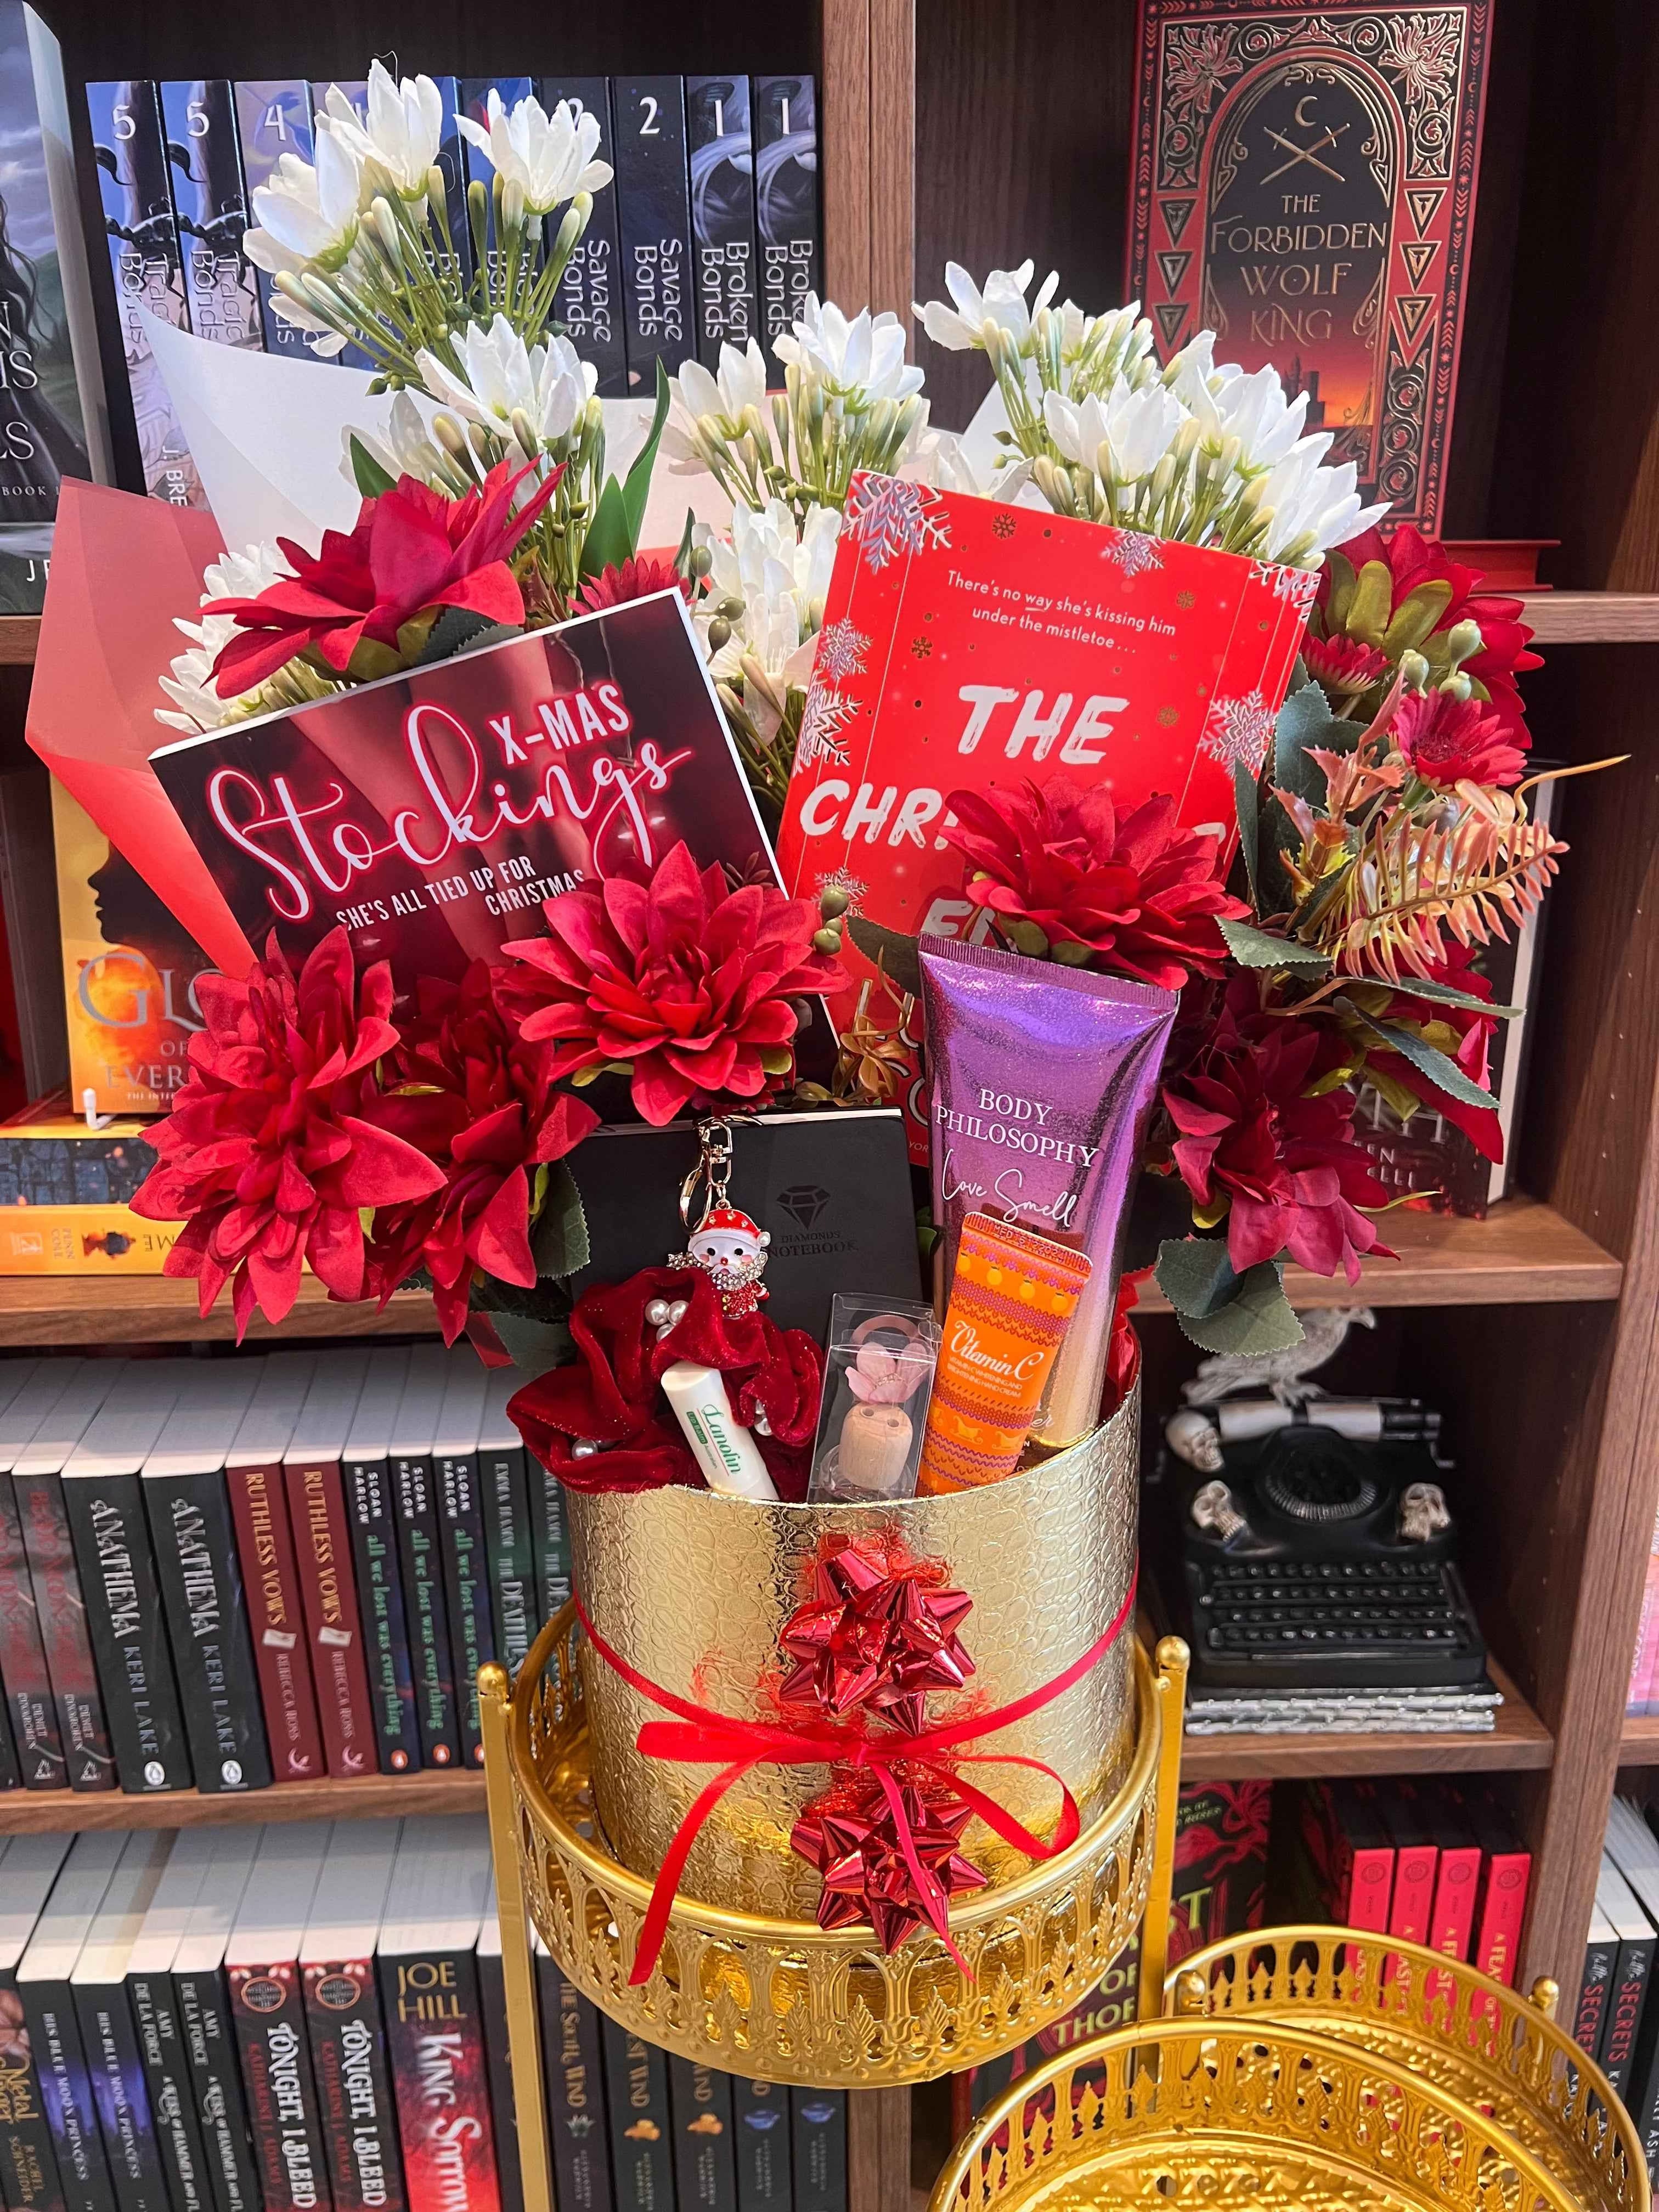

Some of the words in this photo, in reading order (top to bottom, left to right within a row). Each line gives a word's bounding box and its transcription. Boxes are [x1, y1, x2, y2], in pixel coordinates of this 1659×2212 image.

[112, 104, 136, 140] 5
[186, 101, 210, 138] 5
[264, 105, 286, 141] 4
[639, 97, 660, 134] 2
[715, 99, 724, 137] 1
[782, 98, 789, 134] 1
[1282, 194, 1321, 213] THE
[1211, 215, 1386, 254] FORBIDDEN
[191, 251, 225, 339] Bonds
[218, 251, 247, 340] Tragic
[564, 247, 591, 338] Bonds
[588, 240, 611, 342] Savage
[634, 246, 663, 336] Bonds
[661, 239, 682, 341] Savage
[702, 249, 731, 338] Bonds
[726, 242, 753, 341] Broken
[765, 247, 795, 336] Bonds
[1241, 263, 1352, 296] WOLF
[1250, 303, 1333, 347] KING
[2, 486, 46, 496] BOOK
[948, 570, 999, 596] There's
[1003, 588, 1020, 601] no
[1025, 592, 1052, 611] way
[1057, 596, 1091, 617] she's
[1095, 604, 1145, 631] kissing
[1149, 616, 1176, 635] him
[973, 607, 1016, 625] under
[1019, 615, 1042, 632] the
[489, 683, 631, 765] X-MAS
[957, 684, 1130, 764] THE
[210, 704, 691, 919] Stockings
[336, 899, 390, 930] SHE'S
[391, 890, 426, 916] ALL
[424, 875, 468, 904] TIED
[470, 867, 494, 891] UP
[498, 856, 536, 883] FOR
[978, 1088, 1053, 1126] BODY
[936, 1105, 1099, 1167] PHILOSOPHY
[942, 1148, 987, 1200] Love
[995, 1169, 1077, 1227] Smell
[768, 1241, 859, 1259] NOTEBOOK
[781, 1231, 840, 1243] DIAMONDS
[951, 1320, 1014, 1376] Vitamin
[1013, 1352, 1044, 1380] C
[701, 1404, 741, 1473] Lanolin
[354, 1467, 370, 1524] HARLOW
[368, 1472, 382, 1518] SLOAN
[399, 1462, 414, 1519] HARLOW
[412, 1467, 427, 1513] SLOAN
[443, 1461, 457, 1518] HARLOW
[456, 1465, 471, 1512] SLOAN
[303, 1471, 335, 1564] RUTHLESS
[411, 1530, 430, 1551] all
[454, 1528, 474, 1550] all
[246, 1473, 278, 1567] RUTHLESS
[262, 1570, 287, 1625] VOWS
[366, 1535, 385, 1555] all
[414, 1555, 427, 1577] we
[457, 1555, 470, 1576] we
[370, 1560, 382, 1582] we
[318, 1568, 342, 1623] VOWS
[373, 1586, 390, 1617] lost
[417, 1581, 434, 1611] lost
[459, 1580, 477, 1611] lost
[123, 1647, 148, 1693] KERI
[201, 1645, 225, 1692] KERI
[132, 1701, 159, 1756] LAKE
[211, 1700, 237, 1754] LAKE
[398, 1961, 456, 1996] JOE
[398, 1994, 467, 2023] HILL
[1574, 1984, 1604, 2055] SECRET
[1608, 1982, 1641, 2063] SECRETS
[282, 2140, 317, 2208] BLEED
[353, 2137, 387, 2206] BLEED
